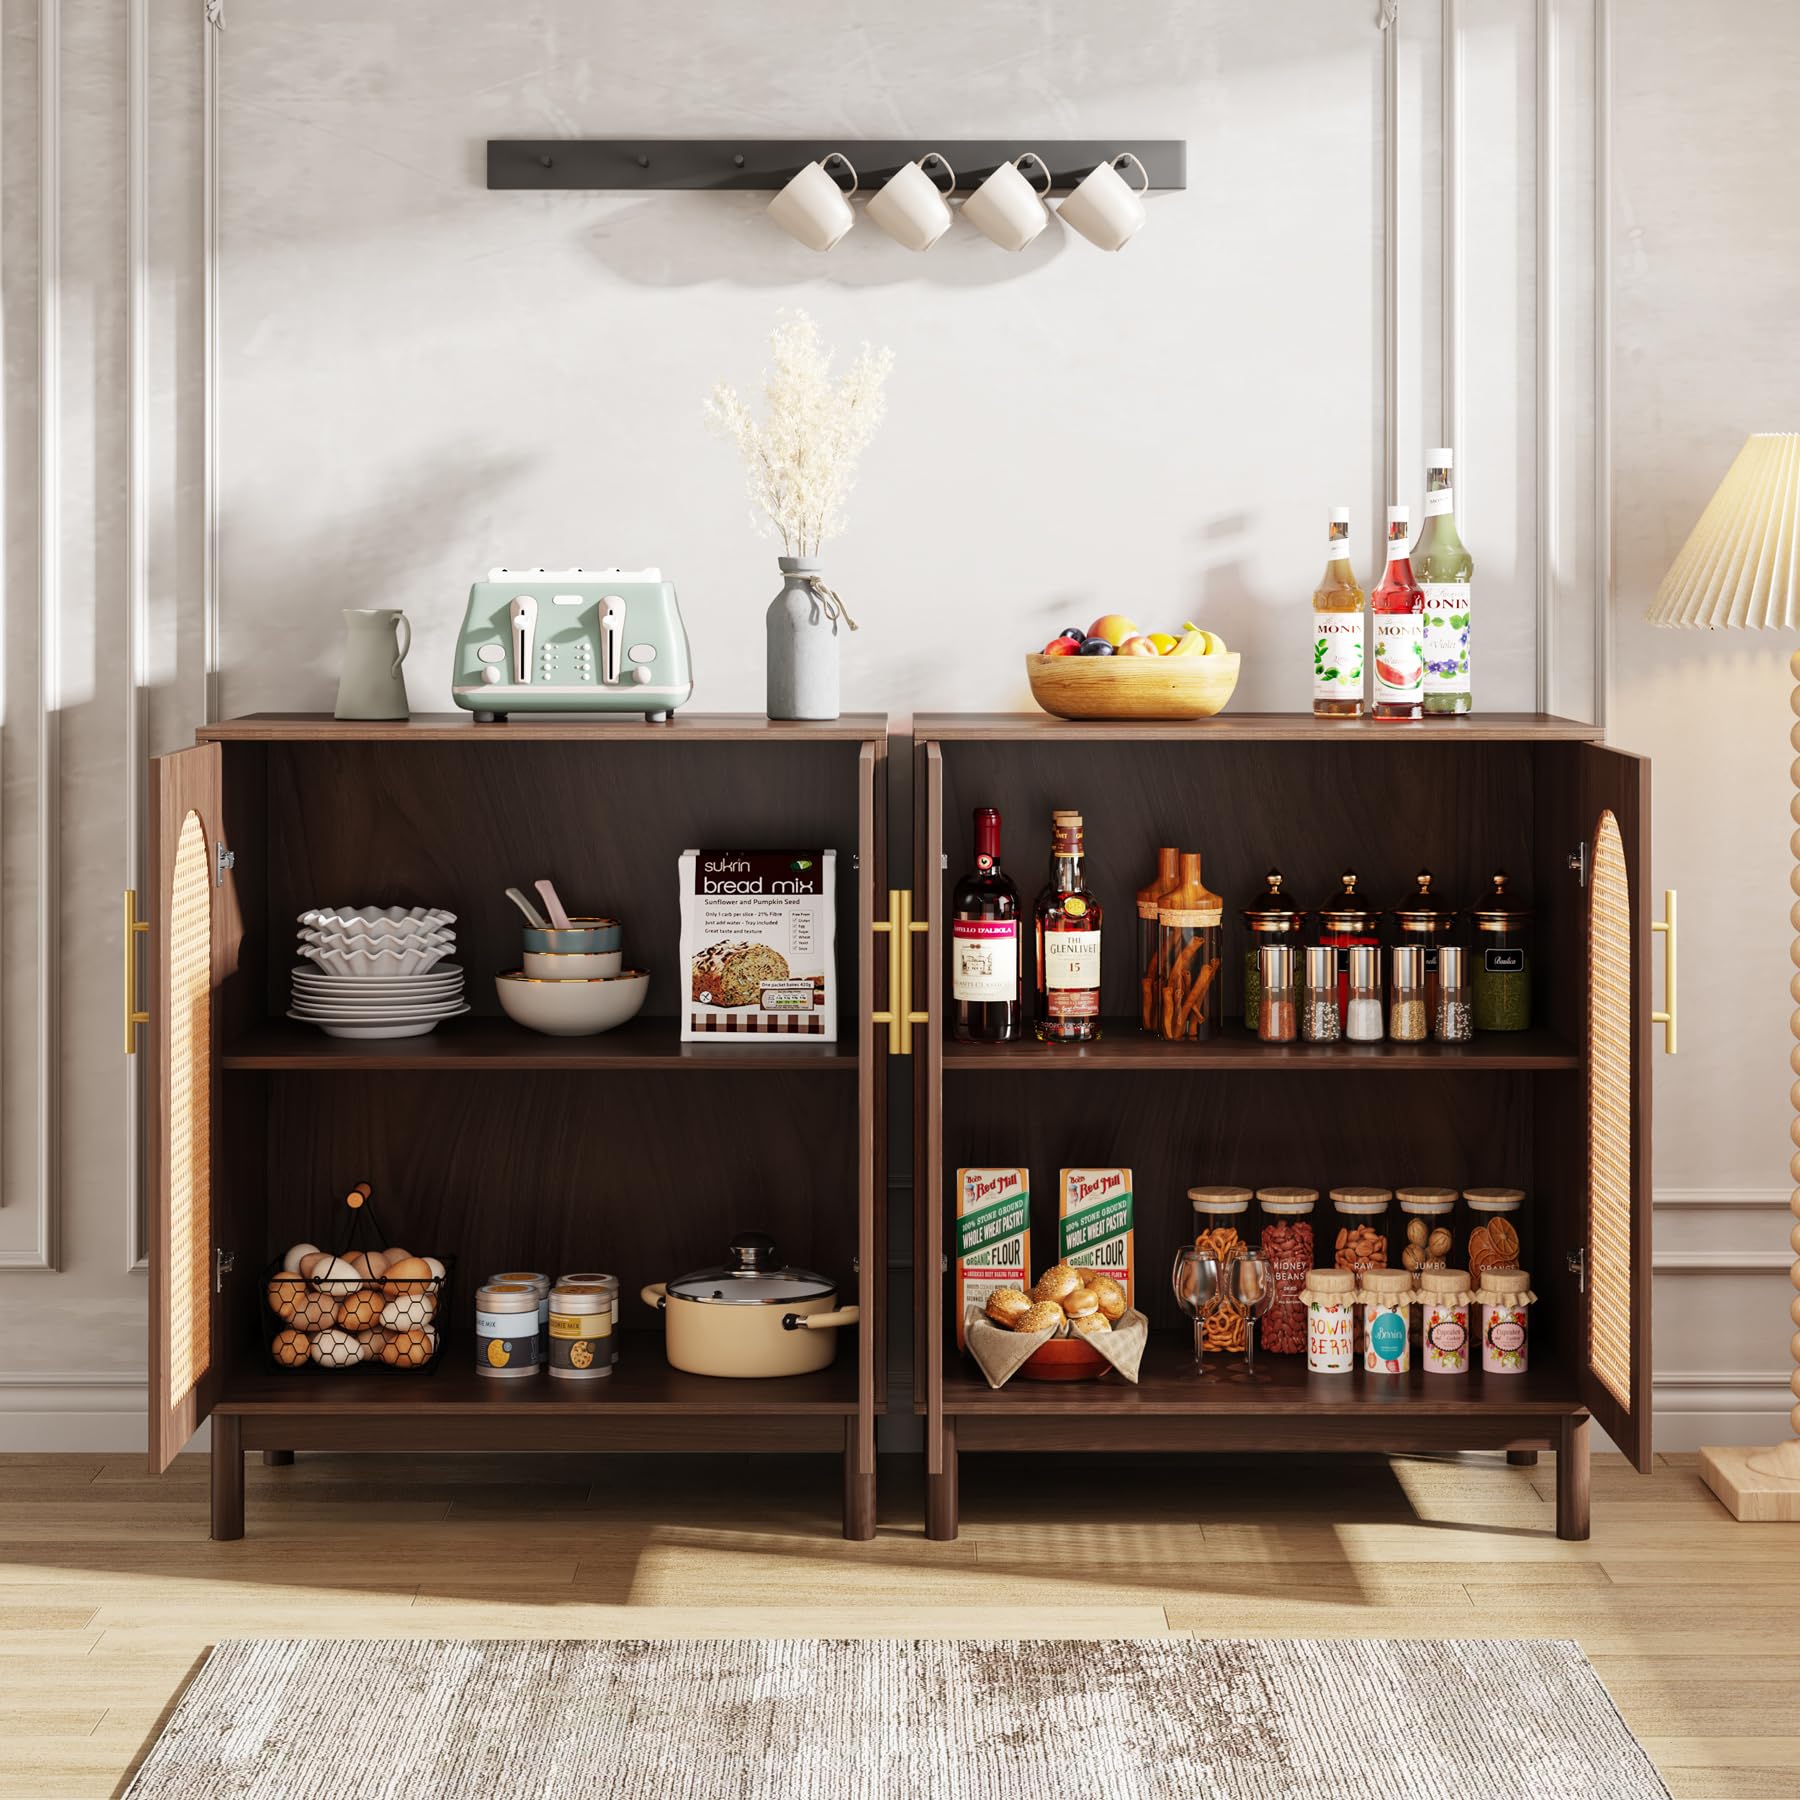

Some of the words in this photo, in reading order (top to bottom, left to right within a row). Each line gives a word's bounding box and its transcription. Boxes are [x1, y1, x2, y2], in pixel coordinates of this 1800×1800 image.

[1425, 599, 1469, 609] ONIN
[704, 857, 751, 873] sukrin
[703, 876, 763, 894] bread
[771, 877, 814, 894] mix
[704, 898, 738, 906] Sunflower
[753, 898, 783, 906] Pumpkin
[1050, 943, 1096, 954] GLENLIVET
[1069, 962, 1081, 972] 15
[975, 1178, 996, 1201] Red
[997, 1173, 1017, 1194] Mill
[1079, 1179, 1100, 1201] Red
[1100, 1174, 1121, 1195] Mill
[962, 1222, 976, 1232] 100%
[976, 1211, 997, 1225] STONE
[998, 1199, 1024, 1216] GROUND
[1065, 1222, 1079, 1233] 100%
[1080, 1211, 1101, 1226] STONE
[1101, 1200, 1127, 1216] GROUND
[962, 1227, 983, 1250] WHOLE
[983, 1218, 1002, 1241] WHEAT
[1002, 1208, 1024, 1233] PASTRY
[1066, 1227, 1087, 1250] WHOLE
[1087, 1219, 1105, 1241] WHEAT
[1106, 1209, 1128, 1233] PASTRY
[966, 1250, 991, 1266] ORGANIC
[991, 1238, 1021, 1265] FLOUR
[1069, 1251, 1094, 1266] ORGANIC
[1095, 1239, 1125, 1266] FLOUR
[1273, 1262, 1307, 1270] KIDNEY
[1354, 1262, 1374, 1270] RAW
[1415, 1262, 1446, 1270] JUMBO
[1275, 1272, 1305, 1281] BEANS
